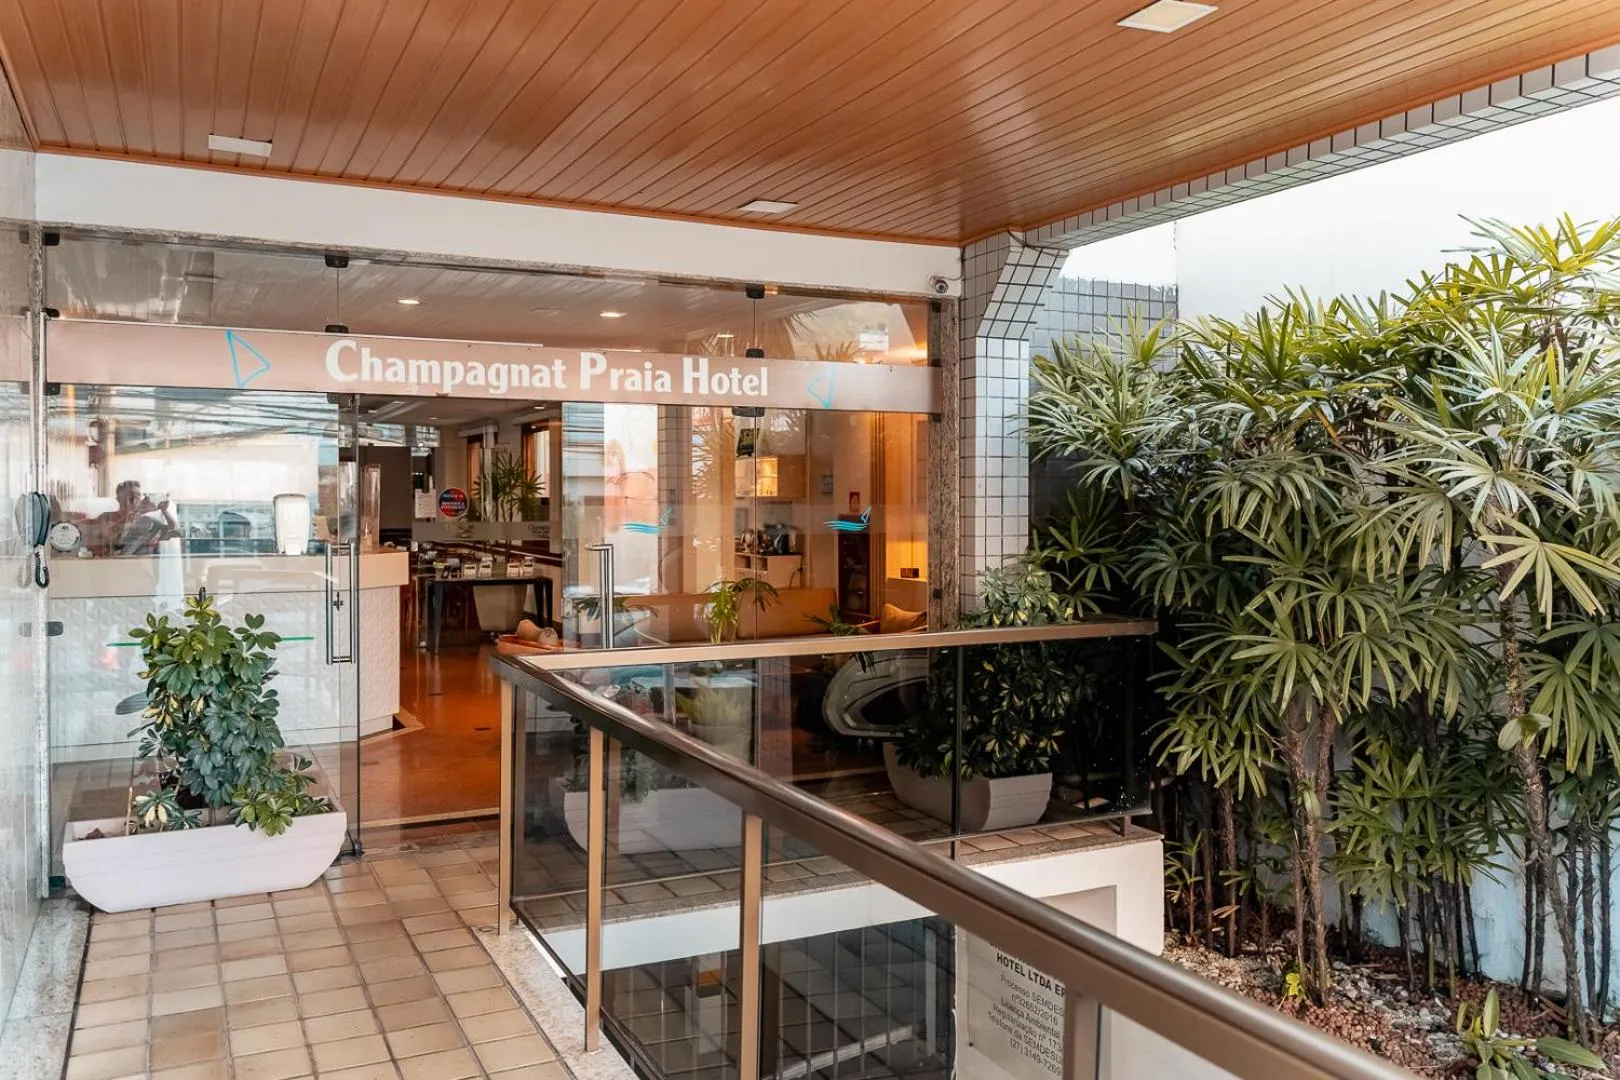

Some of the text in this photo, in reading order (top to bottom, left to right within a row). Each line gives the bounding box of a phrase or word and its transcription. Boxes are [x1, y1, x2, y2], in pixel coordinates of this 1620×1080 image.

[325, 338, 768, 396] Champagnat Praia Hotel
[997, 952, 1026, 977] HOTEL
[1028, 969, 1052, 991] LTDA
